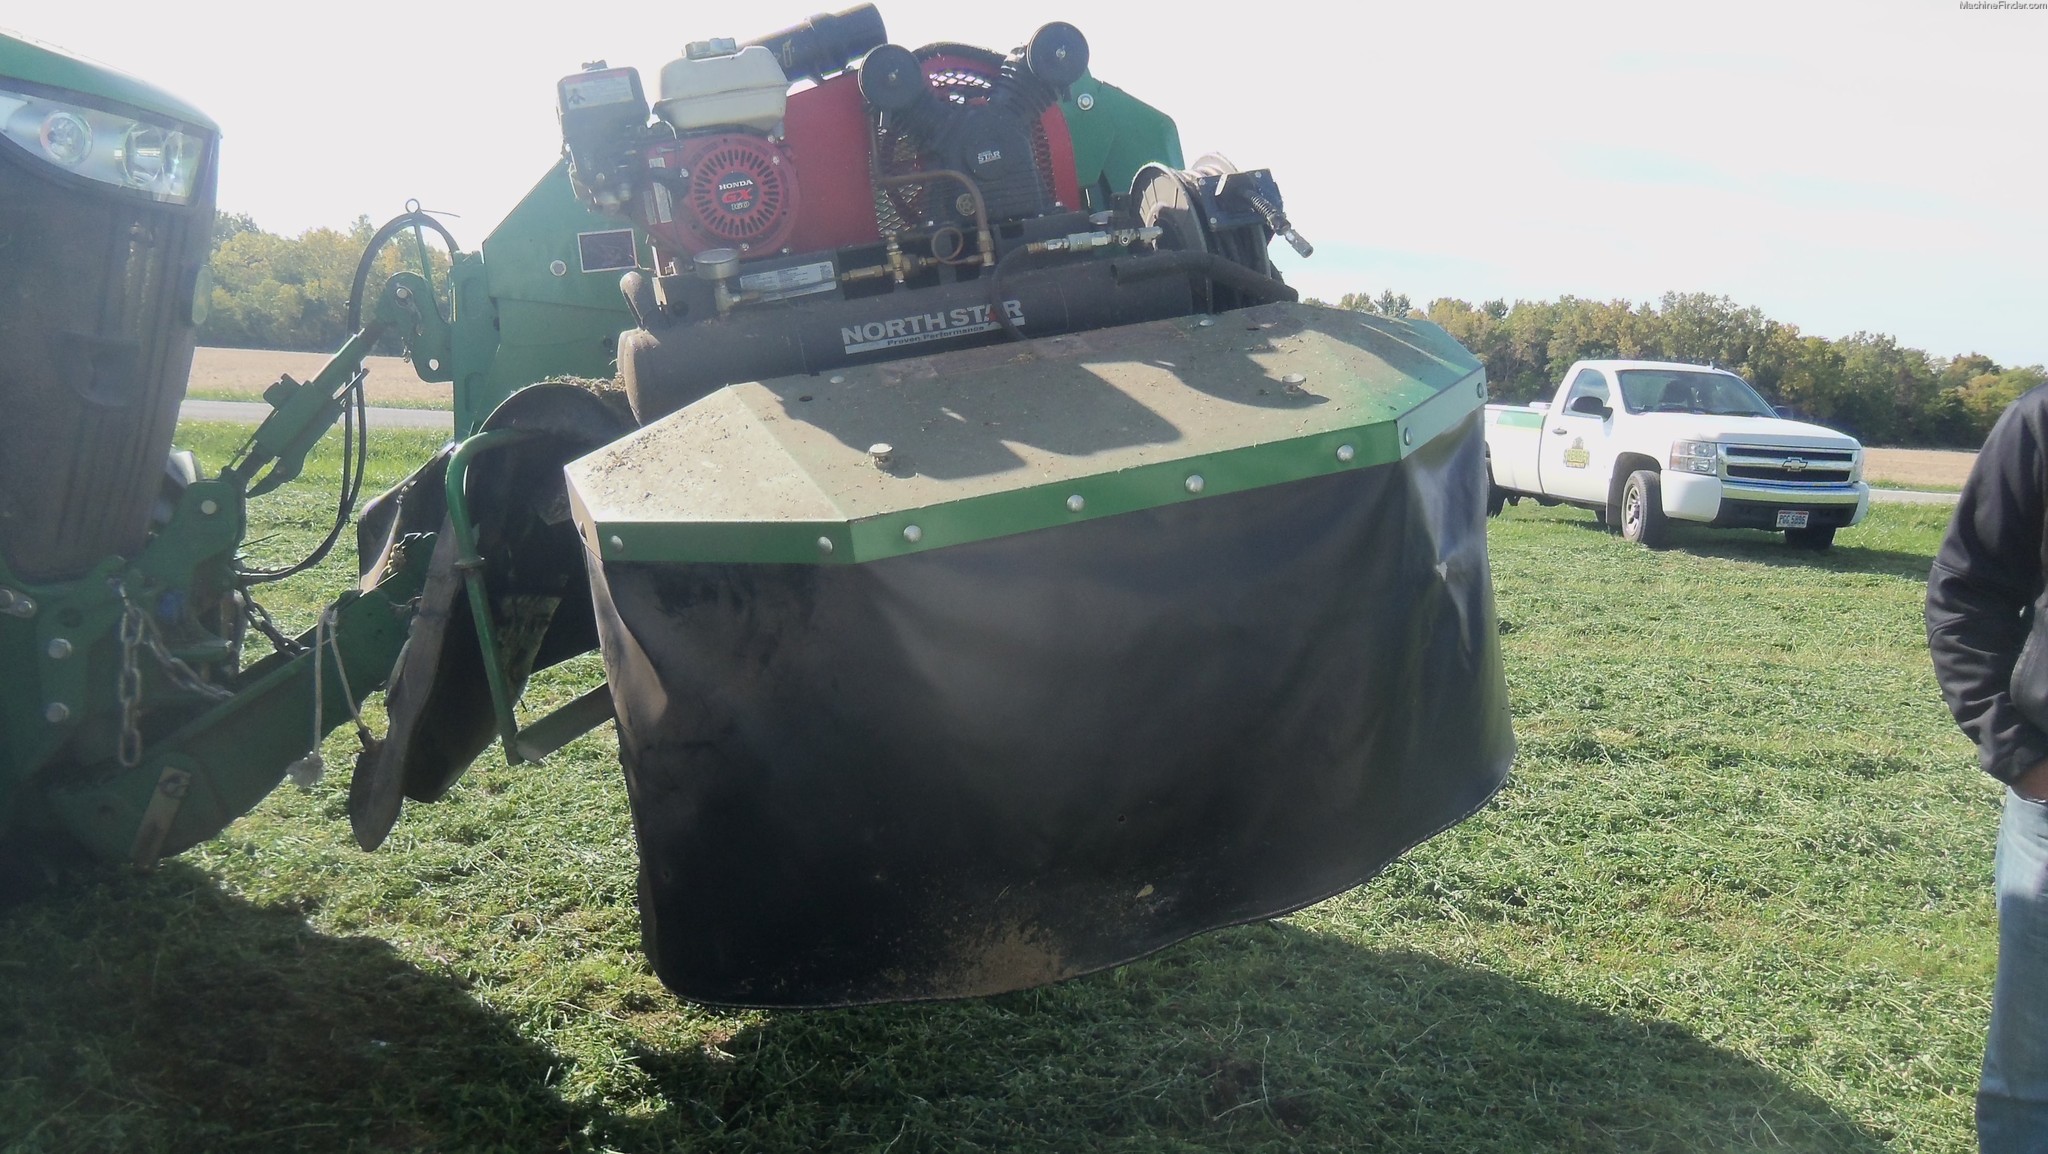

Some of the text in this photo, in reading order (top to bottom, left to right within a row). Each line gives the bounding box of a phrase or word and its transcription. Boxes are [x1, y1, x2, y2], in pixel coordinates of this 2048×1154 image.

[719, 179, 754, 190] HONDA
[722, 188, 753, 203] GX
[887, 326, 985, 346] Proven Performance
